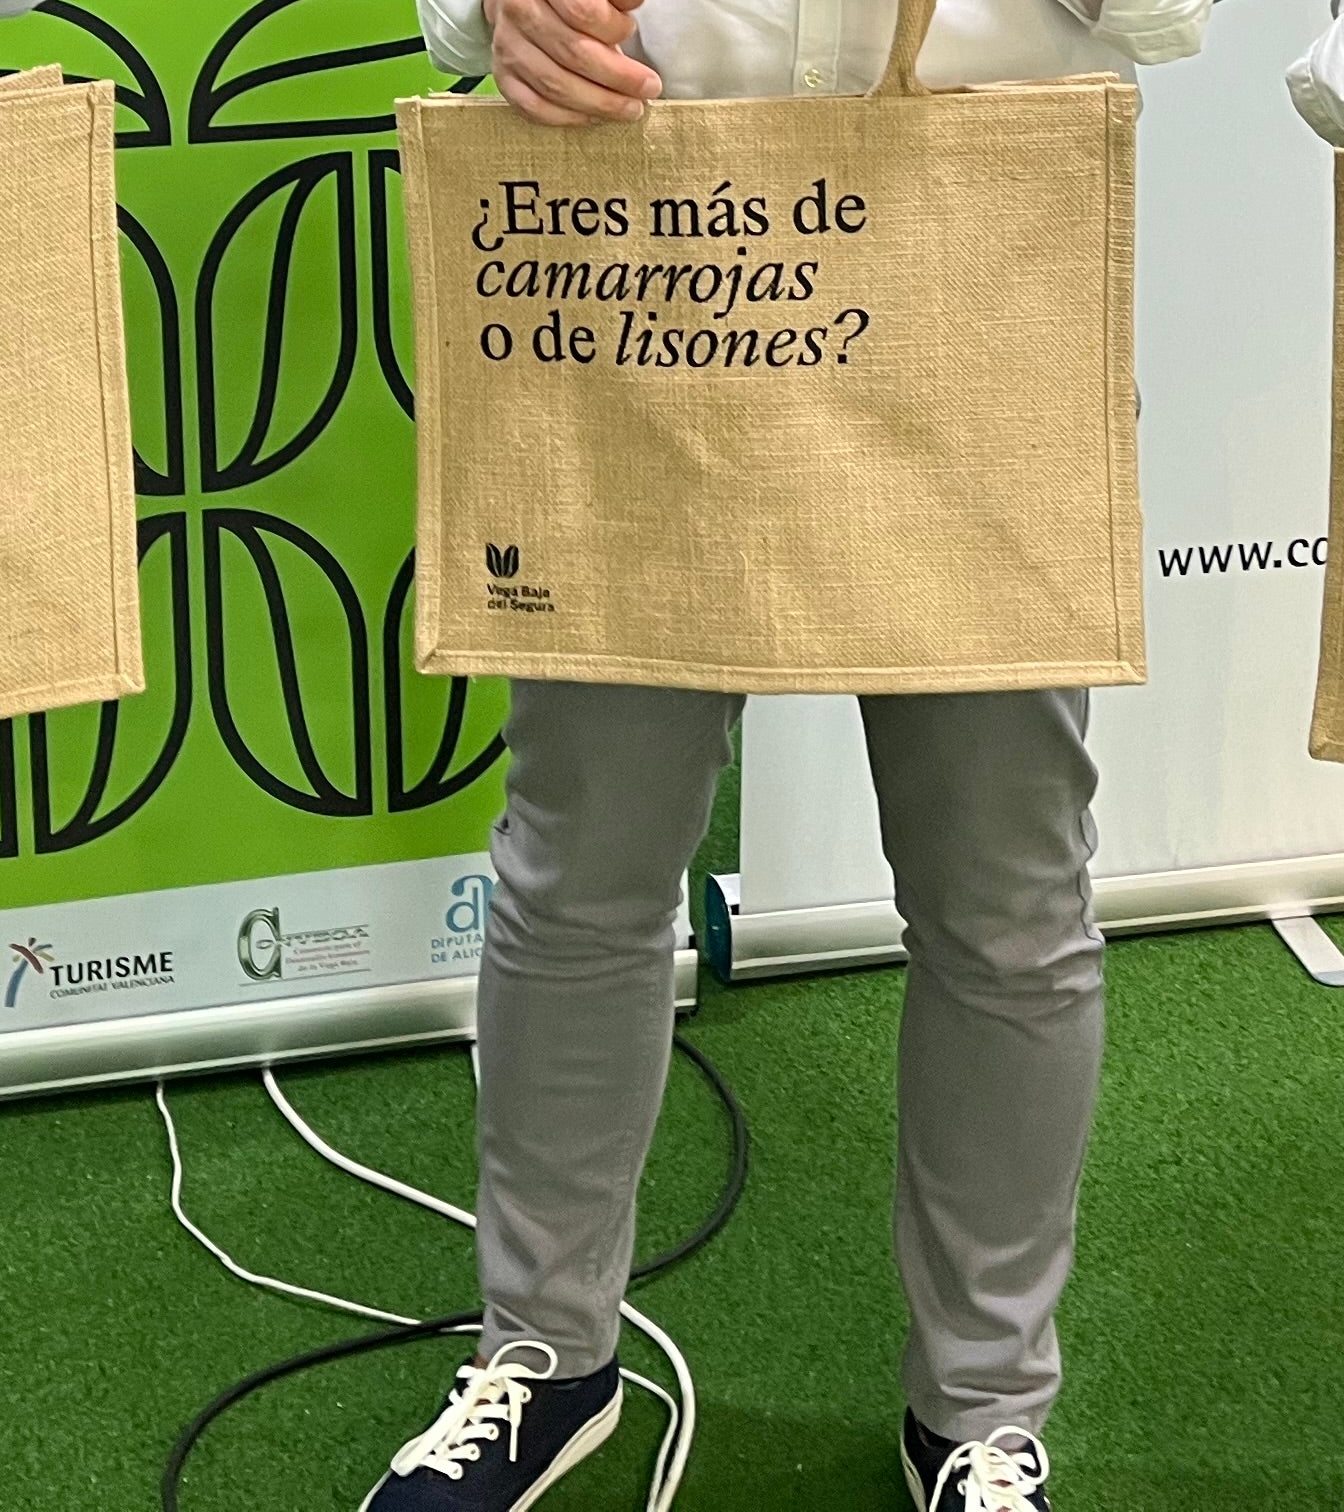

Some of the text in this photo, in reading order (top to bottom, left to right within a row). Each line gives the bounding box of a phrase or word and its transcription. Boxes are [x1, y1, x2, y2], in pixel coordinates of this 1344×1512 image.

[471, 178, 867, 251] ¿Eres más de
[476, 246, 818, 319] camarrojas
[480, 308, 870, 368] o de lisones?
[49, 952, 173, 986] TURISME
[431, 934, 483, 949] DIPUTA
